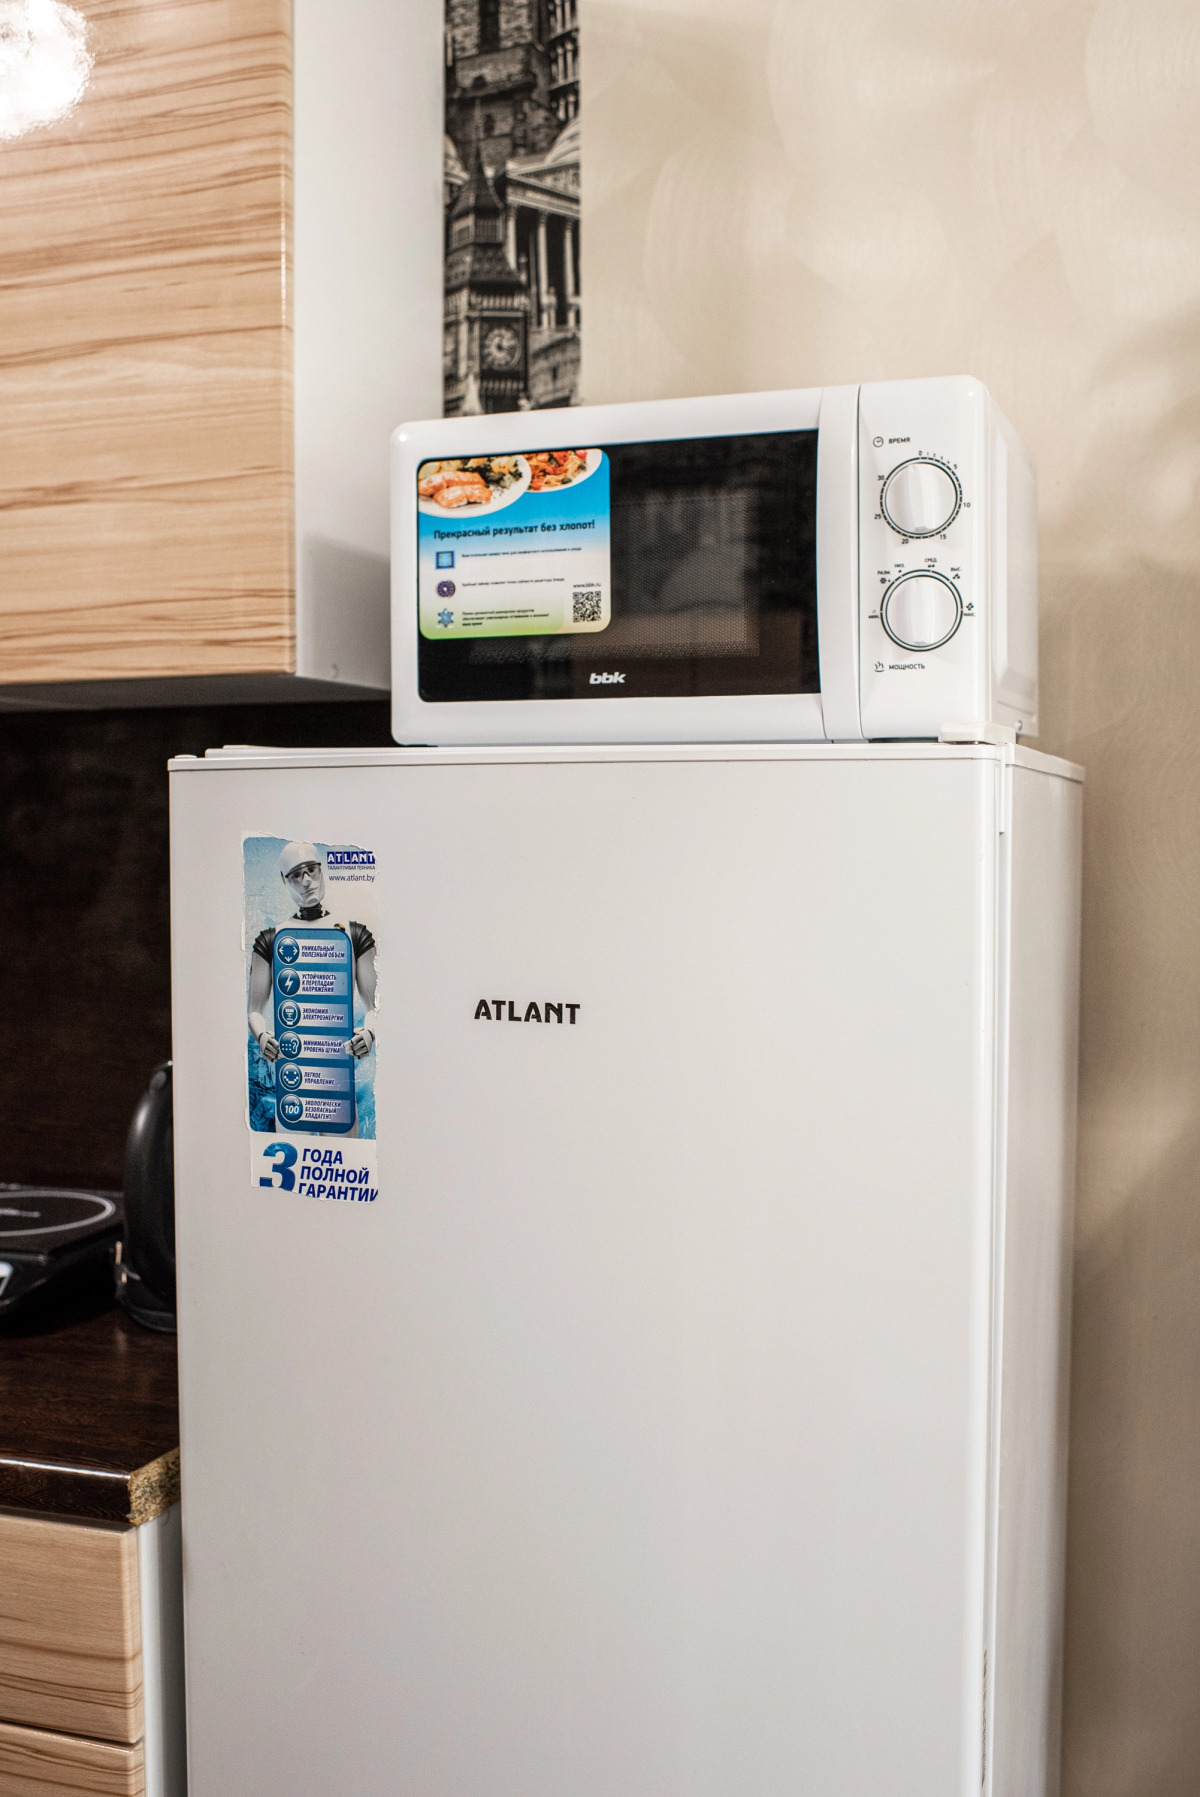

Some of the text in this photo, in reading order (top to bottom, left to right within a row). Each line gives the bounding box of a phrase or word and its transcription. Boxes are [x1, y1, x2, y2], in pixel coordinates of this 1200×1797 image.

[434, 519, 596, 540] Прекрасный результат без хлопот!
[589, 671, 626, 684] bbk
[327, 851, 376, 864] ATLANT
[328, 874, 375, 883] www.atlant.by
[302, 1013, 344, 1021] ЭЛЕКТРОЭНЕРГИИ
[474, 999, 581, 1025] ATLANT
[303, 1040, 342, 1048] МИНИМАЛЬНЫЙ
[285, 1105, 299, 1114] 100
[304, 1100, 341, 1108] ЭКОЛОГИЧЕСКИ
[304, 1106, 336, 1114] БЕЗОПАСНЫЙ
[302, 1148, 343, 1167] ГОДА
[260, 1142, 298, 1192] 3
[300, 1166, 370, 1185] ПОЛНОЙ
